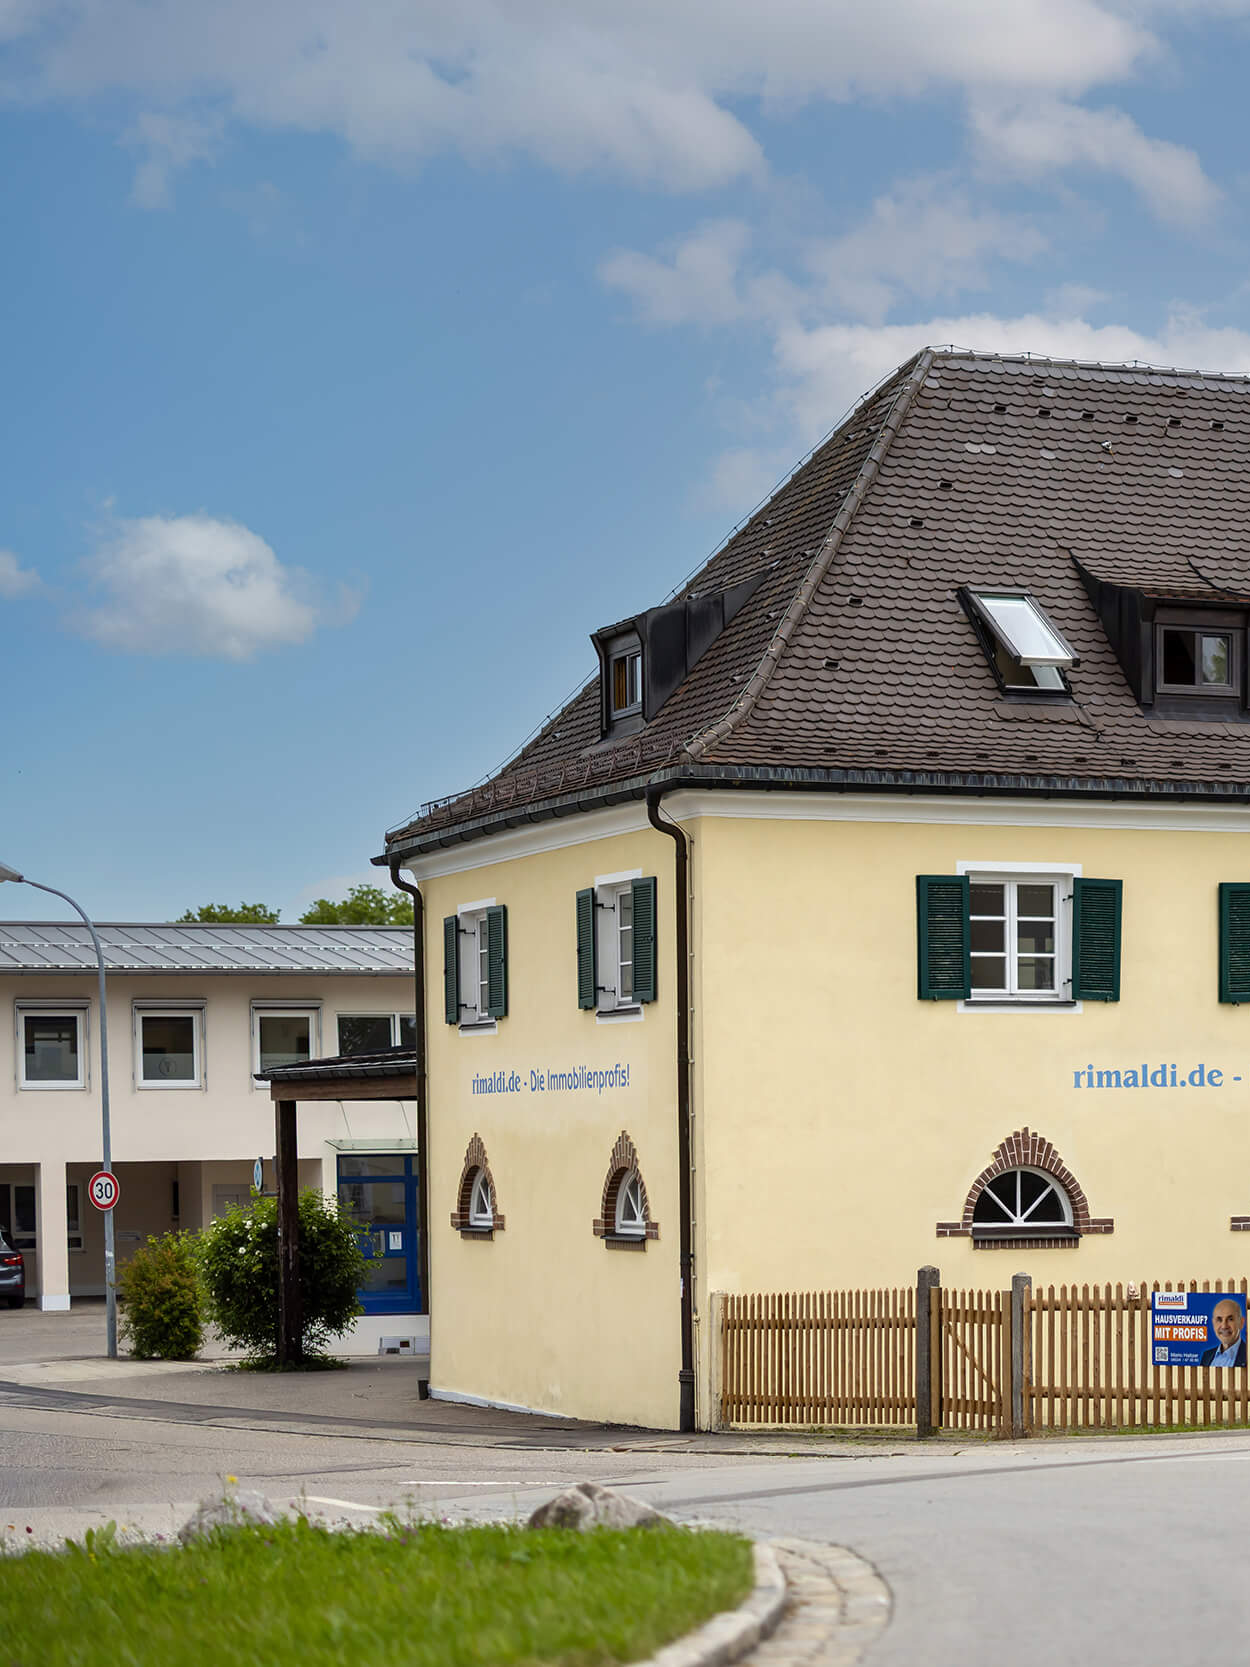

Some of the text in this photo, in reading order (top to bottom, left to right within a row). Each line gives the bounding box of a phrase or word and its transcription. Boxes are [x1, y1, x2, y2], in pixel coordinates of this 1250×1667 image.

[472, 1070, 521, 1095] rimaldi.de
[530, 1068, 545, 1092] Die
[547, 1063, 630, 1095] Immobilienprofis!
[1073, 1063, 1224, 1089] rimaldi.de
[95, 1182, 113, 1199] 30
[1154, 1314, 1208, 1325] HAUSVERKAUF?
[1154, 1327, 1207, 1340] MIT PROFIS.
